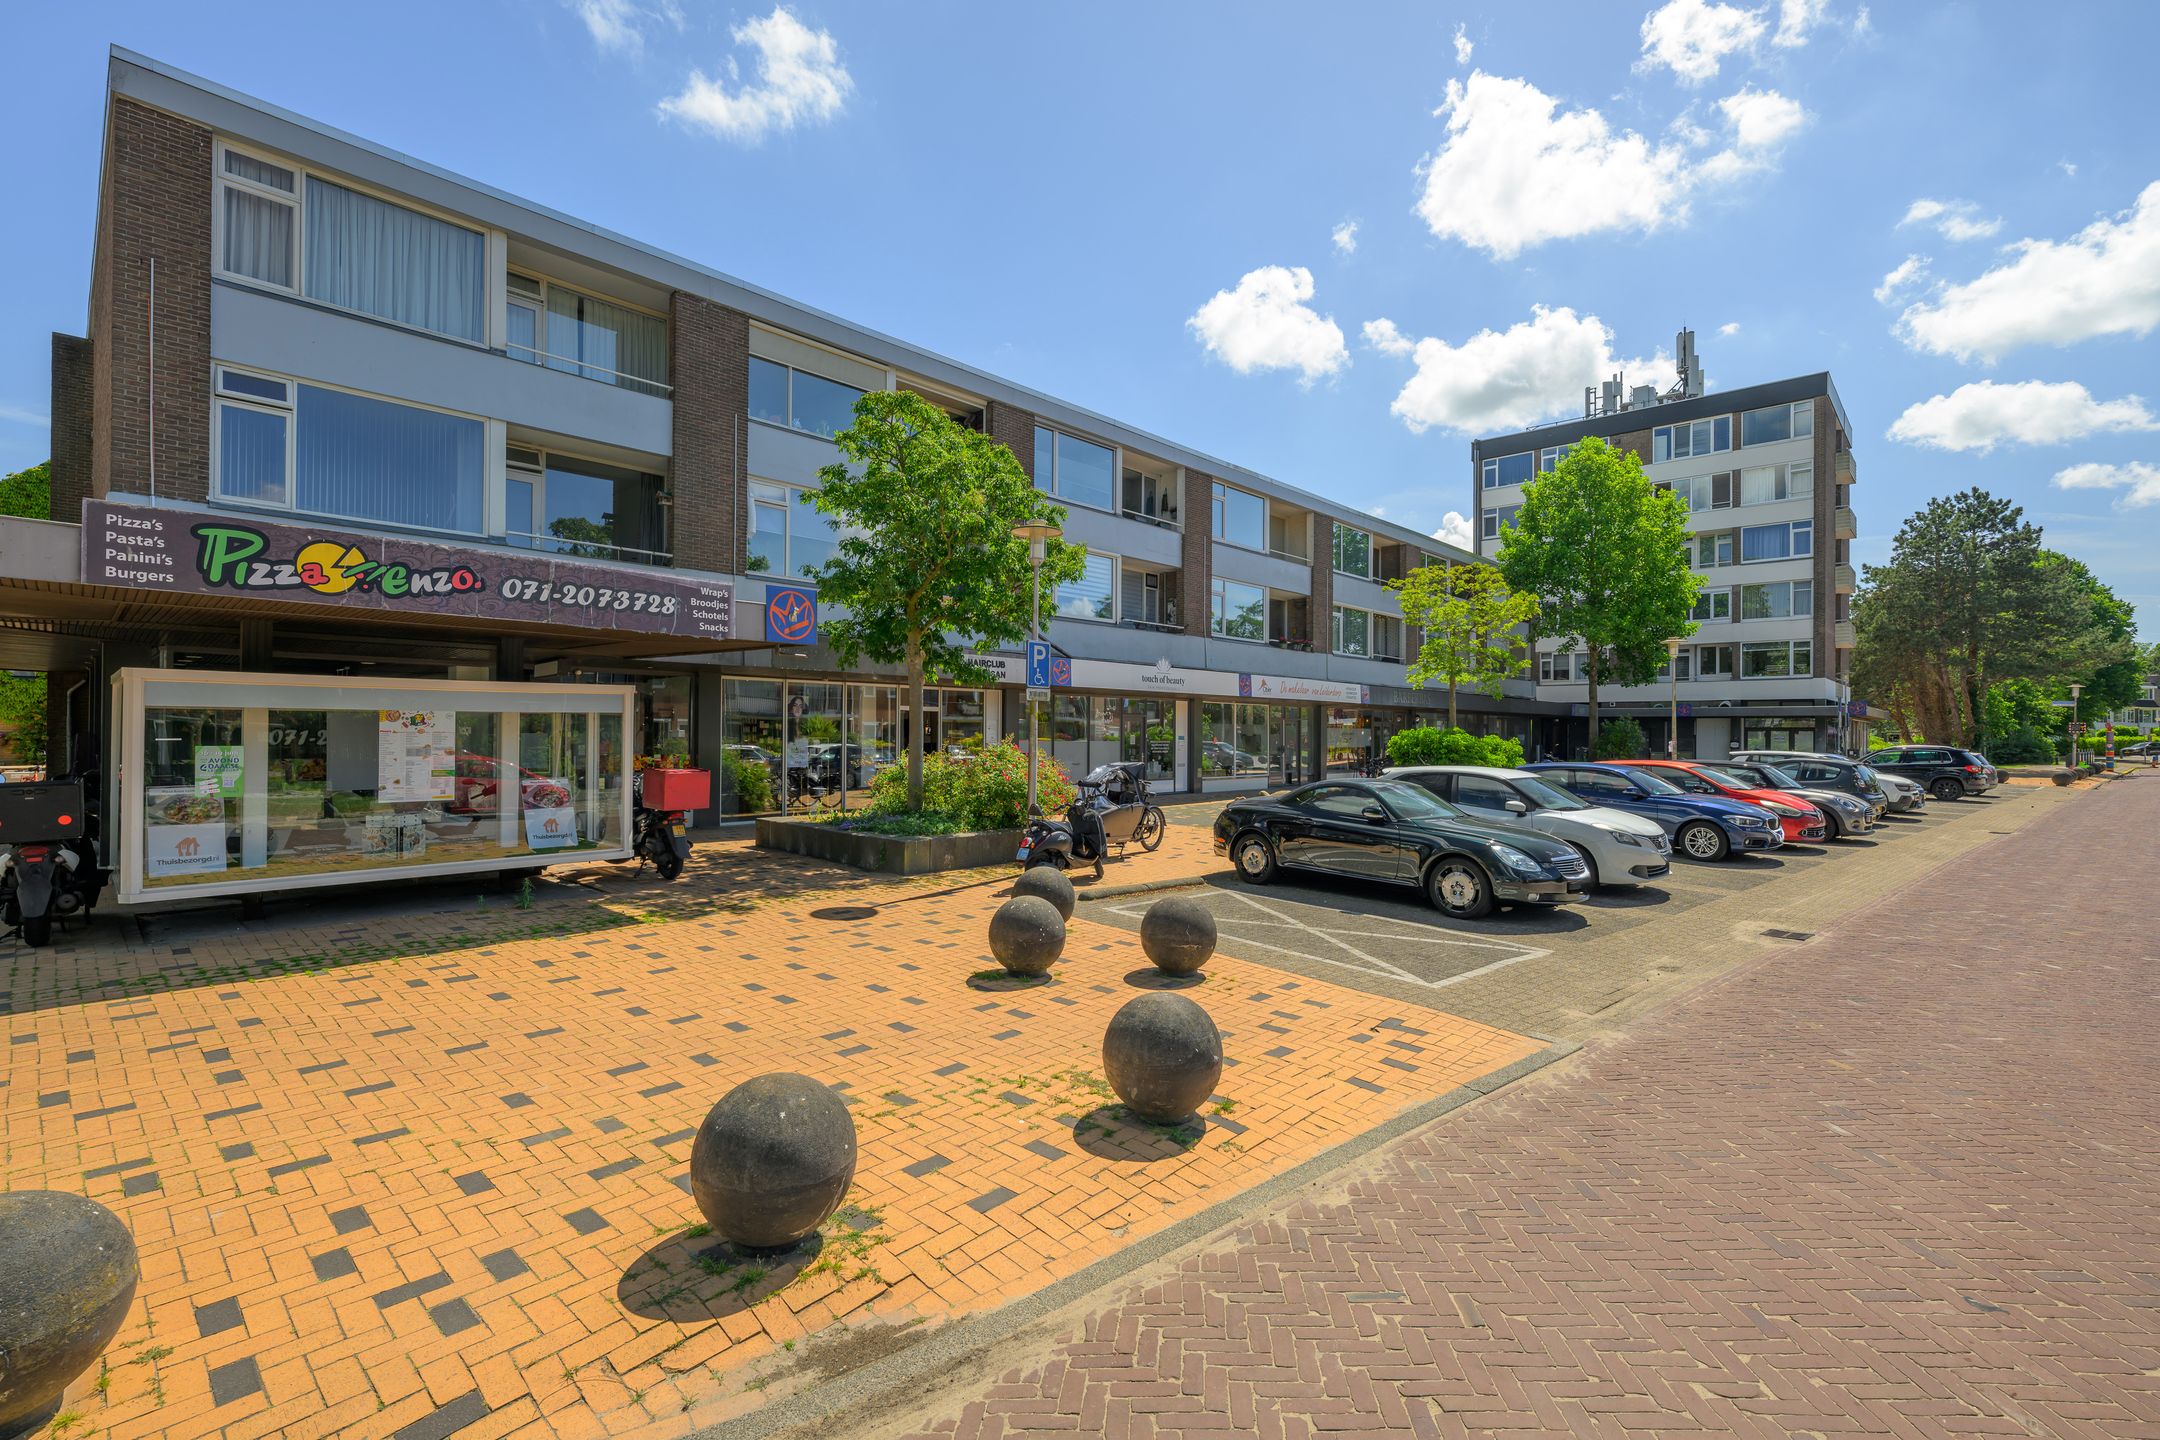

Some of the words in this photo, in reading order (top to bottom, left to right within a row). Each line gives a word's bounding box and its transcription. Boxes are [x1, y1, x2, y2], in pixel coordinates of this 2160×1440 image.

[106, 513, 163, 531] Pizza's
[105, 531, 165, 548] Pasta's
[105, 548, 173, 566] Panini's
[197, 527, 331, 586] Pizza
[105, 565, 174, 583] Burgers
[502, 578, 677, 615] 071-2073728
[700, 586, 729, 599] Wrap's
[690, 598, 729, 611] Broodjes
[692, 610, 729, 621] Schotels
[699, 621, 729, 633] Snacks
[967, 658, 1006, 669] HAIRCLUB
[1033, 645, 1047, 668] P
[1141, 674, 1159, 684] touch
[1159, 675, 1167, 684] of
[1166, 675, 1185, 687] beauty
[157, 855, 220, 867] Thuisbezorgd.nl
